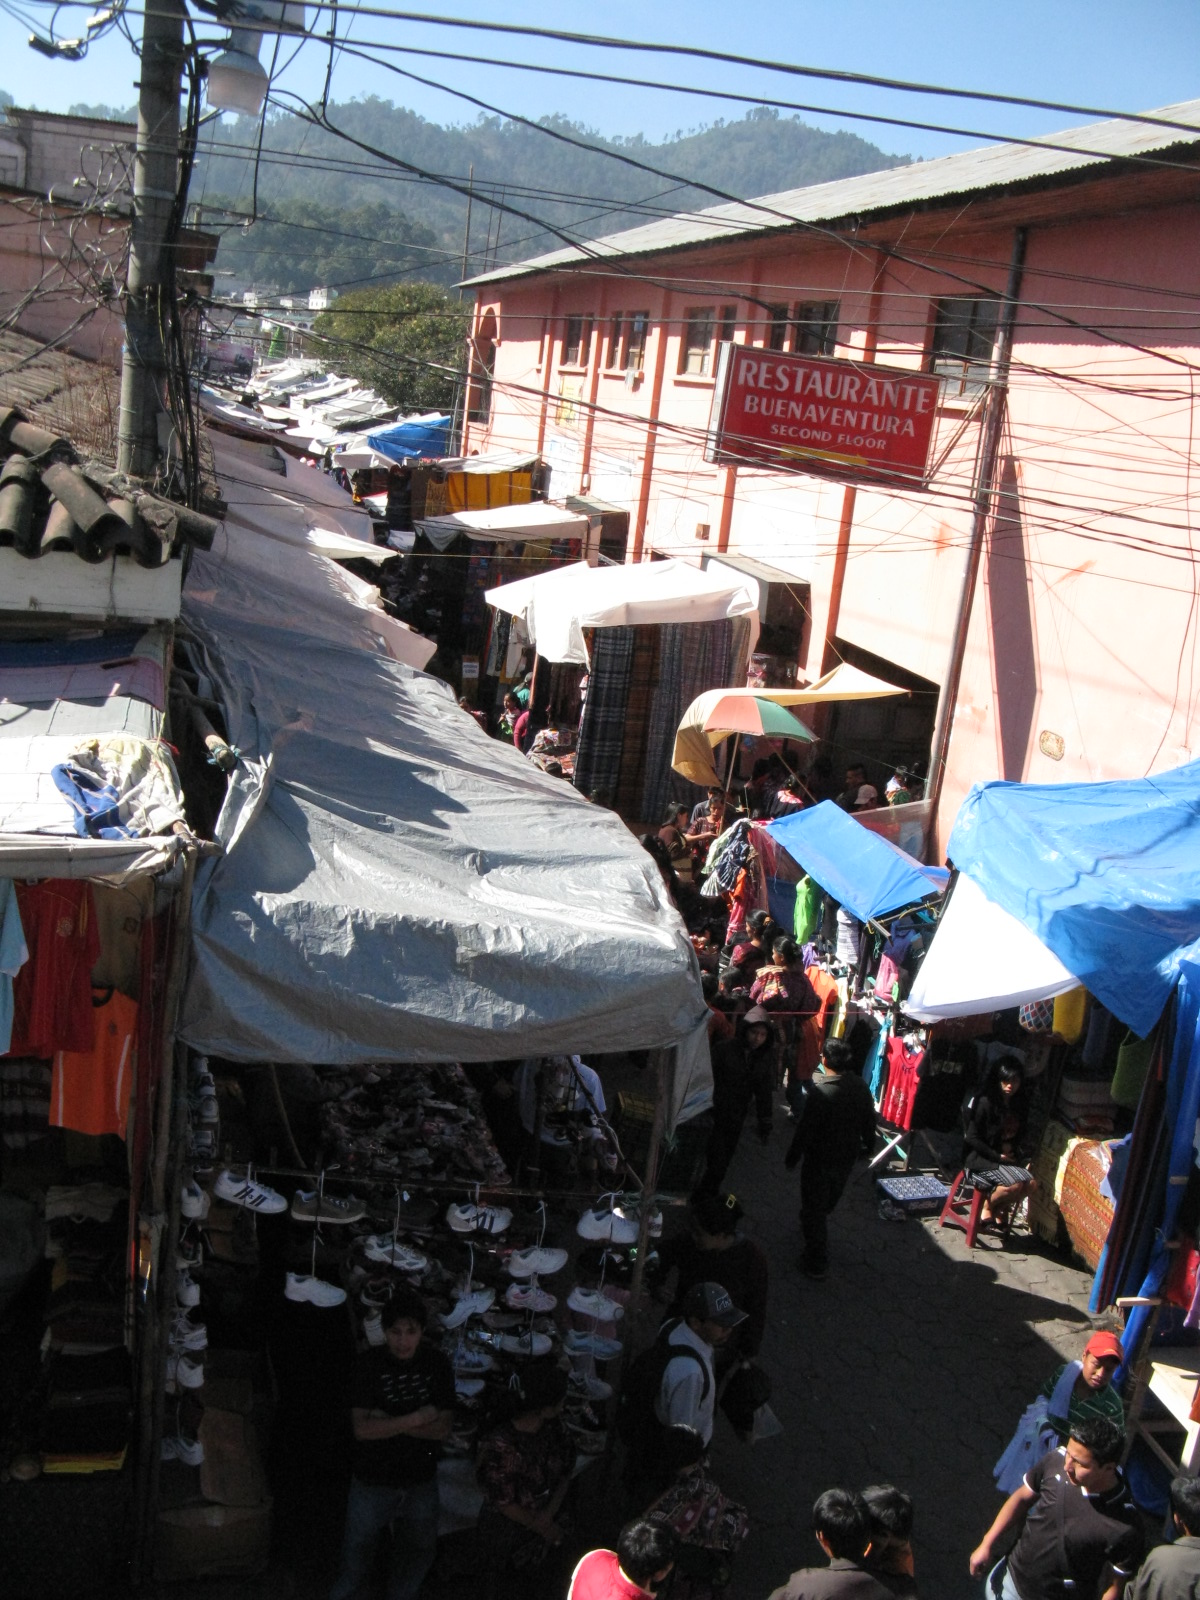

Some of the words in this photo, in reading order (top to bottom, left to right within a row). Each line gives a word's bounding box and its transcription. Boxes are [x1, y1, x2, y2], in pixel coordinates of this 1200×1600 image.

[738, 359, 931, 413] RESTAURANTE
[744, 396, 915, 437] BUENAVENTURA
[770, 425, 832, 442] SECOND
[837, 434, 887, 450] FLOOR
